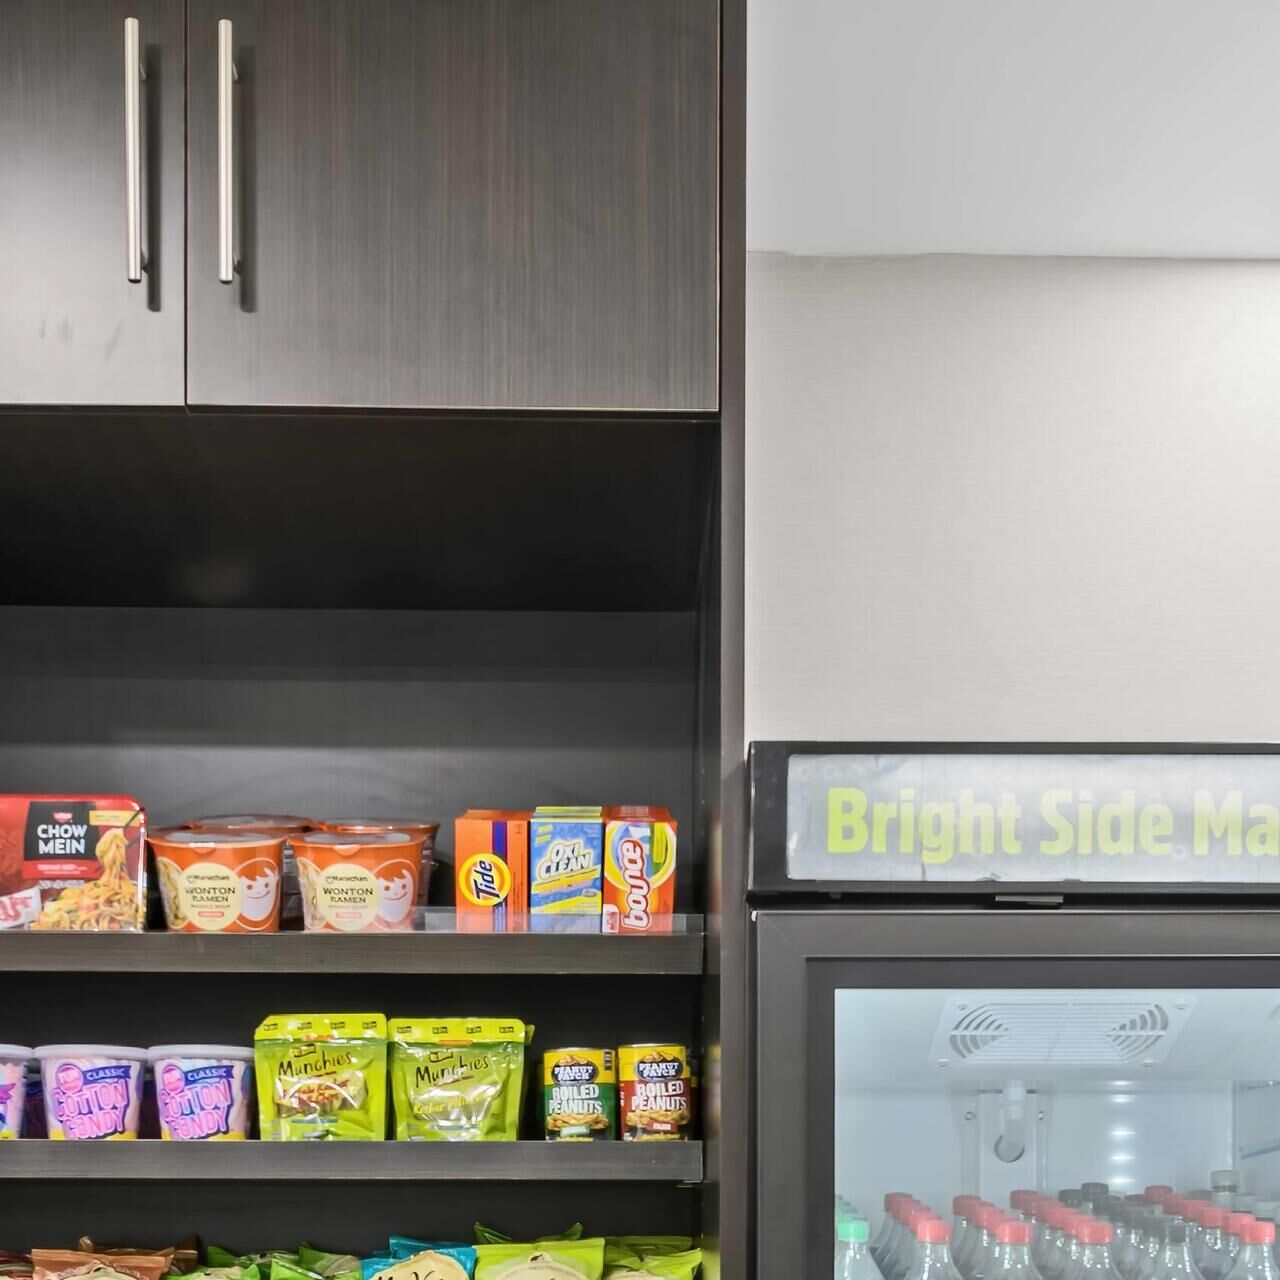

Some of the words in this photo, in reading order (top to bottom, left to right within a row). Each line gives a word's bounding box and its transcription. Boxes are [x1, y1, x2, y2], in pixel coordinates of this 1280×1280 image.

[37, 824, 88, 839] CHOW
[827, 786, 1021, 863] Bright
[1040, 789, 1172, 856] Side
[38, 839, 86, 855] MEIN
[551, 840, 581, 863] OXI
[541, 853, 592, 876] CLEAN
[473, 859, 501, 901] Tide
[623, 841, 651, 929] bounce
[185, 887, 236, 896] WONTON
[323, 887, 374, 896] WONTON
[278, 1051, 352, 1077] Munchies
[86, 1068, 125, 1080] CLASSIC
[186, 1068, 227, 1081] CLASSIC
[552, 1084, 599, 1100] BOILED
[637, 1080, 684, 1097] BOILED
[549, 1099, 602, 1114] PEANUTS
[631, 1096, 687, 1111] PEANUTS
